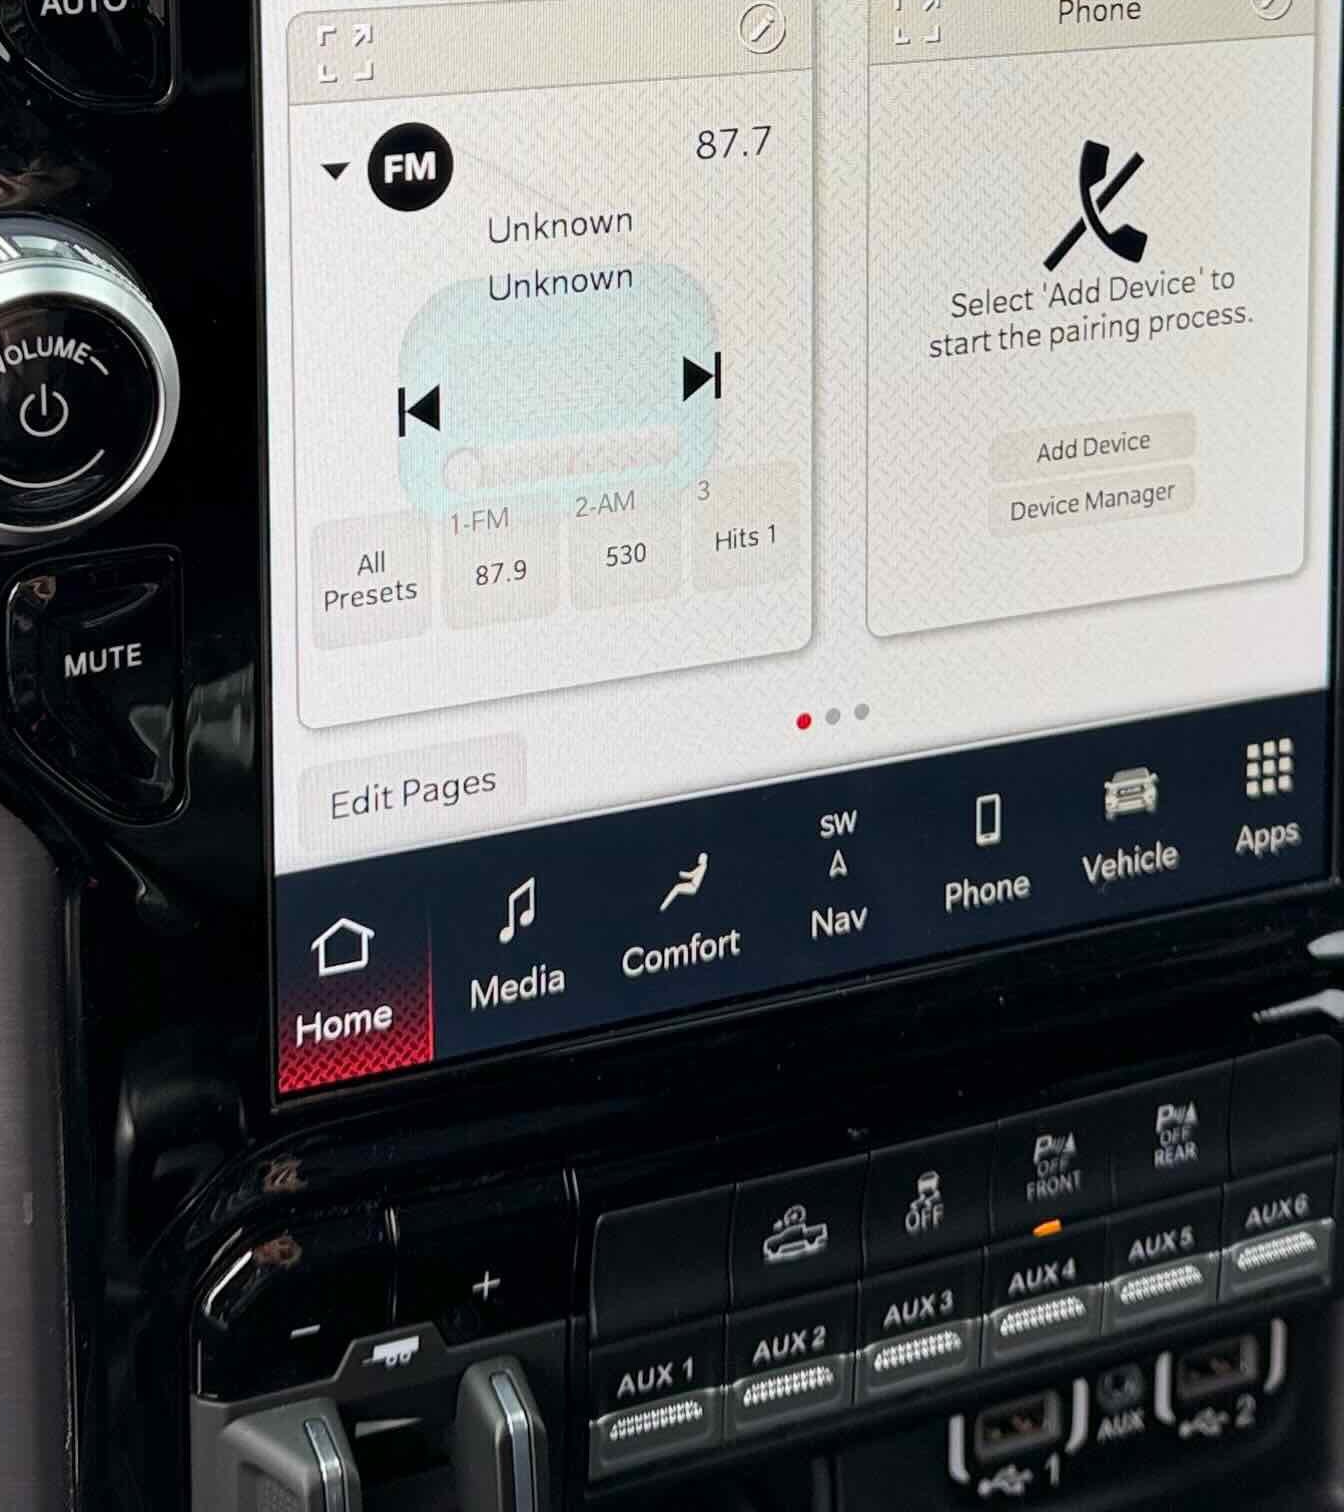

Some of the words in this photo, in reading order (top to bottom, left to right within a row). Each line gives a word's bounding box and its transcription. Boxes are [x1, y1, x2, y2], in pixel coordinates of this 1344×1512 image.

[696, 125, 772, 160] 87.7
[383, 151, 436, 184] FM
[488, 208, 634, 244] Unknown
[488, 266, 634, 301] Unknown
[950, 289, 1033, 318] Select
[1042, 277, 1101, 308] 'Add
[1110, 267, 1203, 301] Device'
[1211, 268, 1235, 288] to
[929, 333, 991, 358] start
[999, 322, 1042, 348] the
[1049, 312, 1140, 349] pairing
[1148, 305, 1253, 338] process.
[1036, 436, 1077, 463] Add
[1083, 432, 1151, 457] Device
[575, 489, 636, 518] 2-AM
[696, 480, 711, 501] 3
[1010, 492, 1080, 521] Device
[1085, 483, 1175, 511] Manager
[450, 505, 510, 536] 1-FM
[714, 528, 759, 551] Hits
[767, 524, 777, 544] 1
[357, 551, 385, 576] All
[605, 542, 647, 567] 530
[475, 559, 528, 586] 87.9
[324, 580, 418, 611] Presets
[64, 642, 143, 678] MUTE
[331, 783, 394, 820] Edit
[402, 771, 497, 808] Pages
[820, 810, 856, 839] SW
[1236, 820, 1300, 855] Apps
[1082, 841, 1179, 884] Vehicle
[945, 874, 1031, 912] Phone
[811, 906, 868, 939] Nav
[622, 929, 742, 978] Comfort
[471, 965, 566, 1010] Media
[296, 1003, 393, 1047] Home
[1154, 1141, 1199, 1169] REAR
[1026, 1170, 1082, 1202] FRONT
[905, 1206, 945, 1234] OFF
[1244, 1199, 1289, 1229] AUX
[1291, 1193, 1310, 1215] 6
[1128, 1234, 1176, 1262] AUX
[1180, 1225, 1196, 1247] 5
[1008, 1263, 1057, 1295] AUX
[1060, 1257, 1077, 1280] 4
[884, 1294, 936, 1328] AUX
[940, 1288, 955, 1311] 3
[753, 1329, 807, 1364] AUX
[810, 1325, 827, 1348] 2
[617, 1362, 673, 1399] AUX
[682, 1356, 695, 1380] 1
[1097, 1409, 1146, 1442] AUX
[1235, 1393, 1256, 1429] 2
[1045, 1451, 1060, 1486] 1
